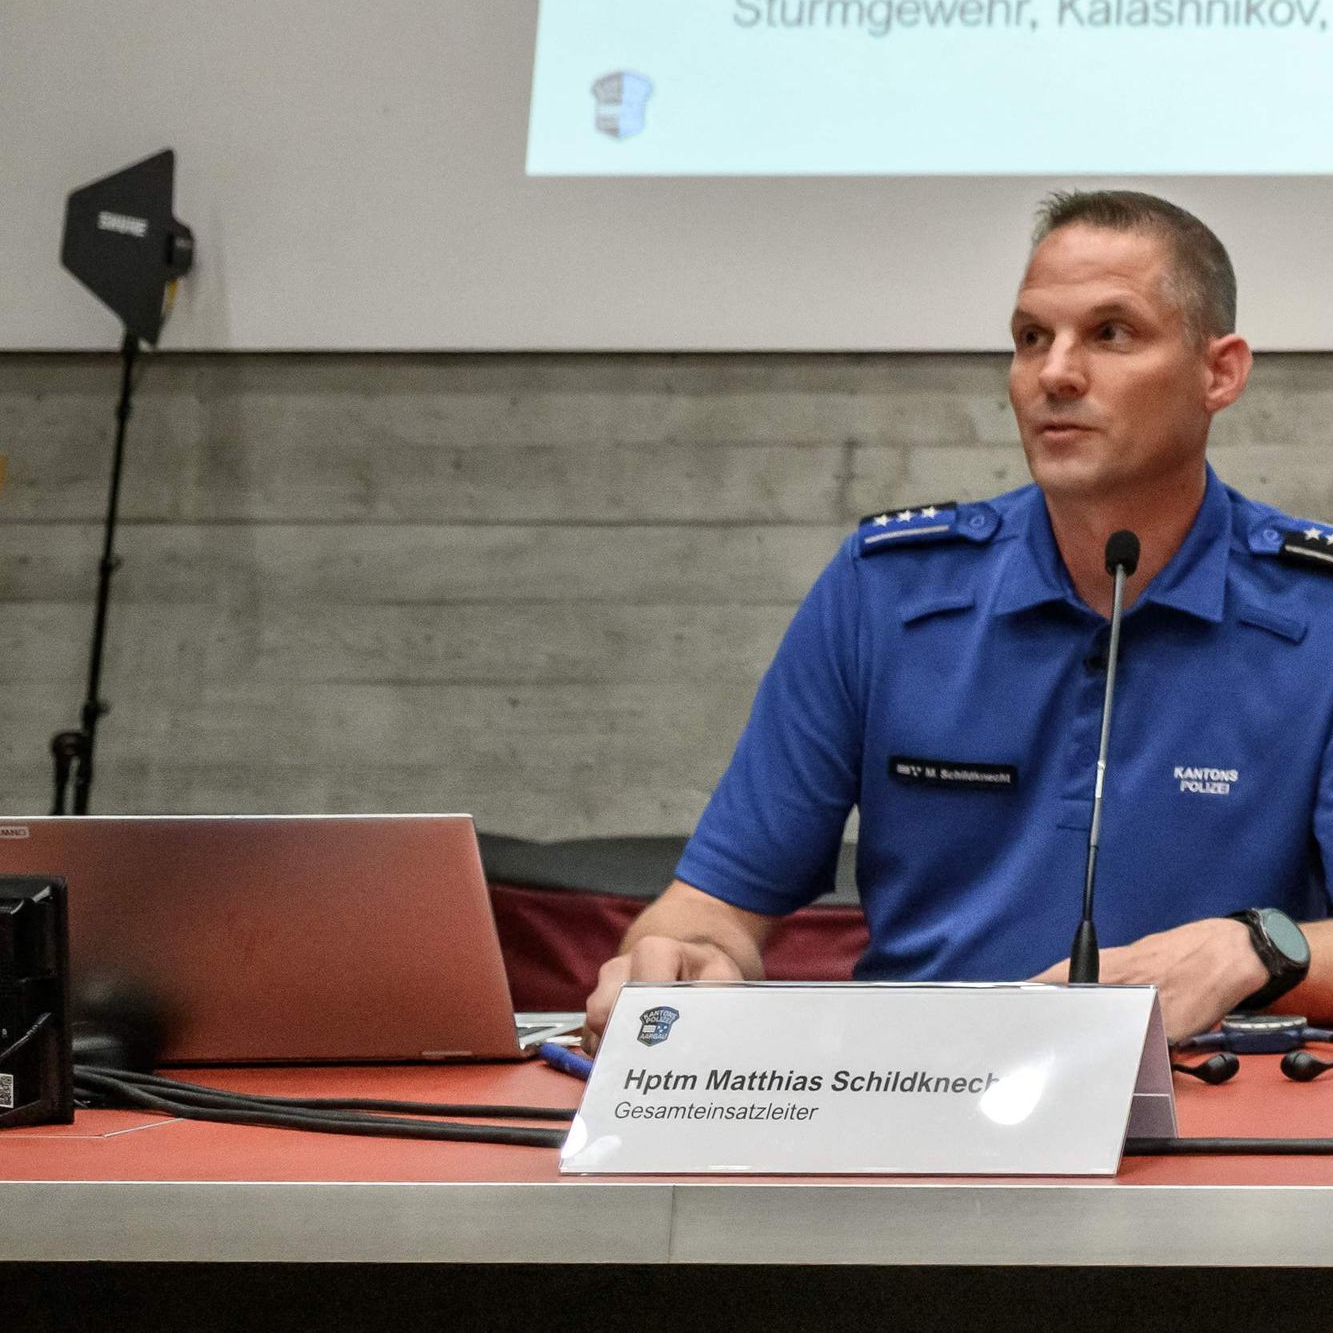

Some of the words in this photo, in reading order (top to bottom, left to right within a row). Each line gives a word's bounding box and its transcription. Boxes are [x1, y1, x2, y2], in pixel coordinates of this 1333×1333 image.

[1174, 766, 1239, 782] KANTONS
[1180, 780, 1230, 794] POLIZEI
[623, 1069, 697, 1095] Hptm
[705, 1069, 823, 1092] Matthias
[831, 1070, 1000, 1094] Schildknech
[614, 1101, 819, 1121] Gesamteinsatzleiter
